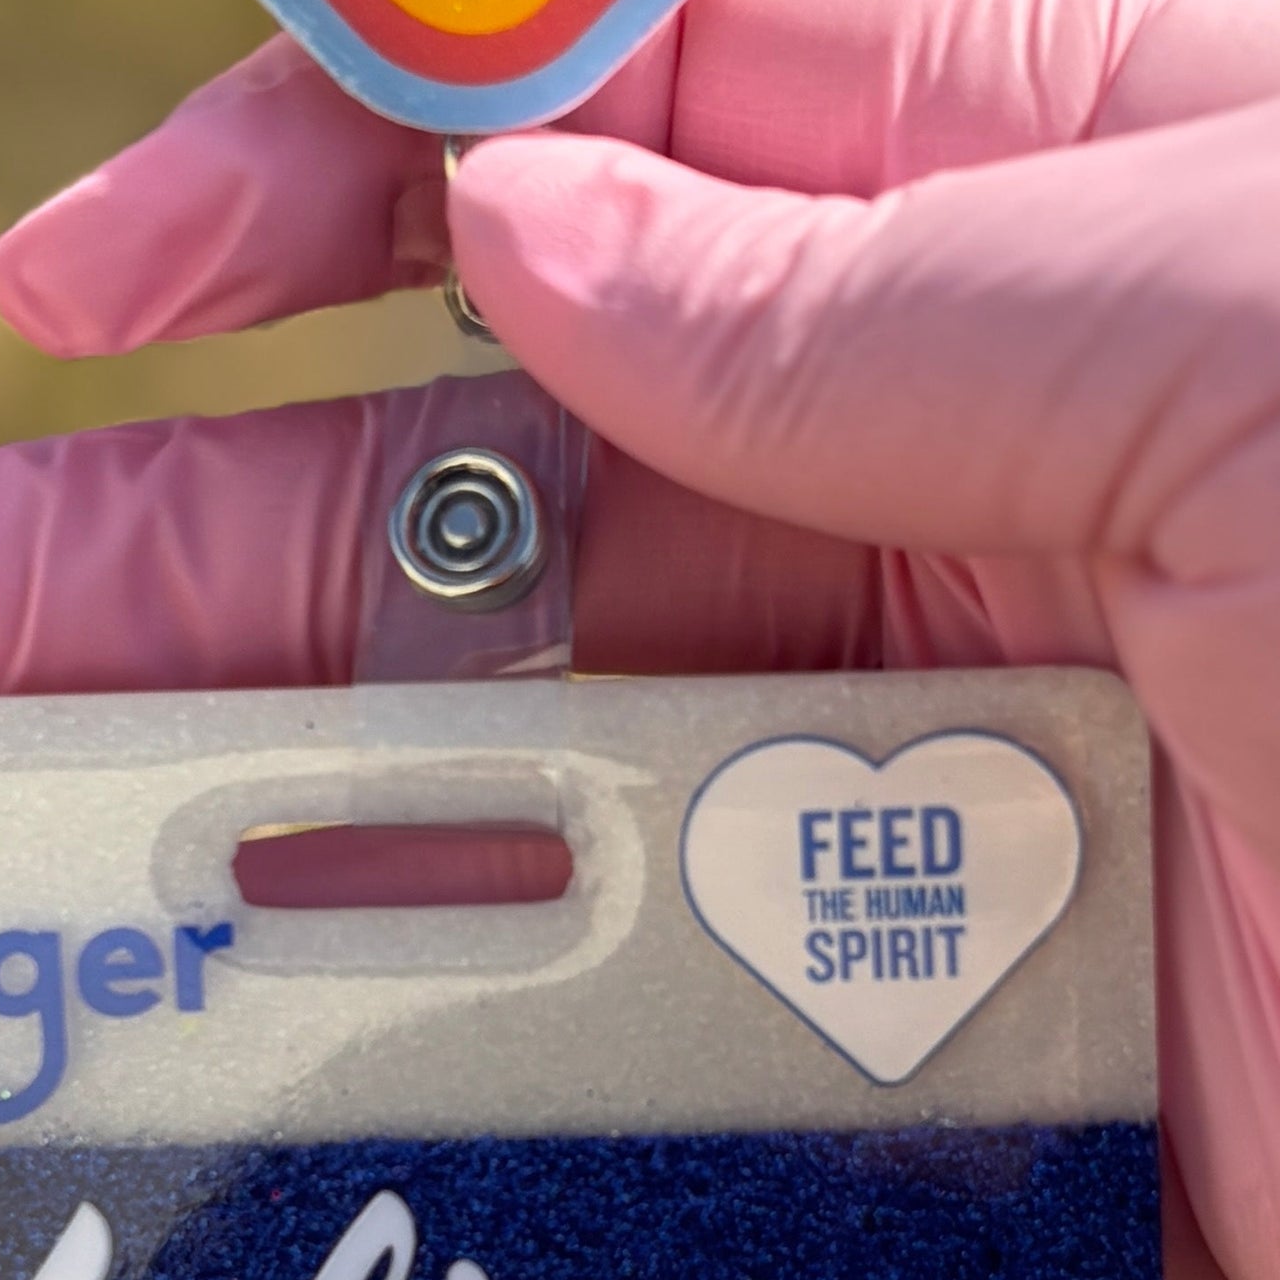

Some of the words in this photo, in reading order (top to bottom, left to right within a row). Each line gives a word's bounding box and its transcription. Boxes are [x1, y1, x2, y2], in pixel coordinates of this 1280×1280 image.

[798, 805, 963, 882] FEED
[803, 887, 854, 923] THE
[865, 884, 965, 919] HUMAN
[805, 926, 966, 984] SPIRIT
